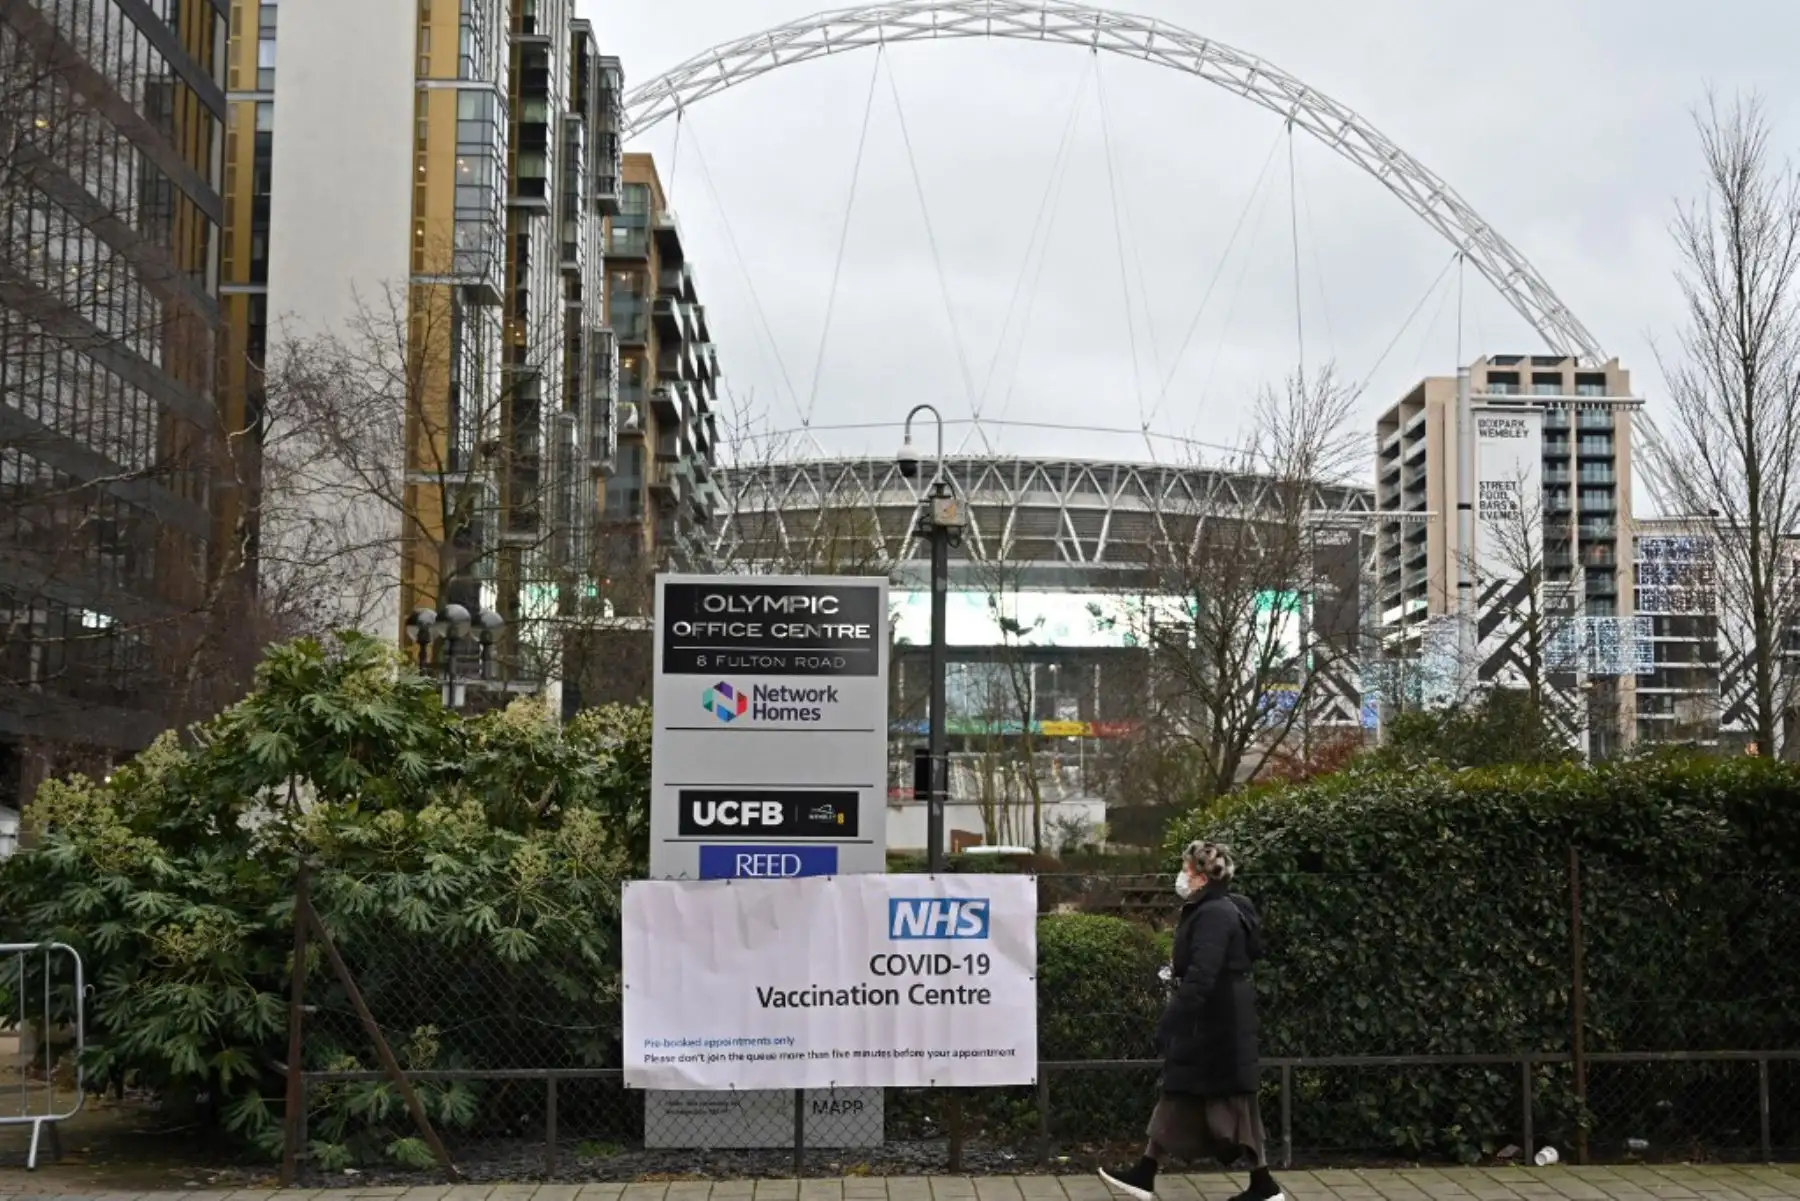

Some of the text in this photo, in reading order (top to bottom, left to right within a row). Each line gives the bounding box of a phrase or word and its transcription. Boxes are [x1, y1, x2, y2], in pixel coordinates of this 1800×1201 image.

[1478, 419, 1526, 428] BOXPARK
[1479, 428, 1529, 438] WEMBLEY
[1479, 481, 1516, 490] STREET
[1480, 501, 1507, 510] BARS
[703, 593, 840, 615] OLYMPIC
[672, 621, 871, 640] OFFICE CENTRE
[696, 655, 847, 669] 8 FULTON ROAD
[752, 684, 839, 704] Network
[752, 703, 822, 722] Homes
[692, 800, 785, 827] UCFB
[735, 853, 803, 877] REED
[892, 901, 986, 937] NHS
[869, 954, 991, 977] COVID-19
[757, 983, 992, 1008] Vaccination Centre
[704, 1036, 772, 1049] appointments
[773, 1035, 795, 1047] only
[644, 1047, 1016, 1065] Please don't join the queue more than five minutes before your appointment
[812, 1099, 866, 1115] MAPP
